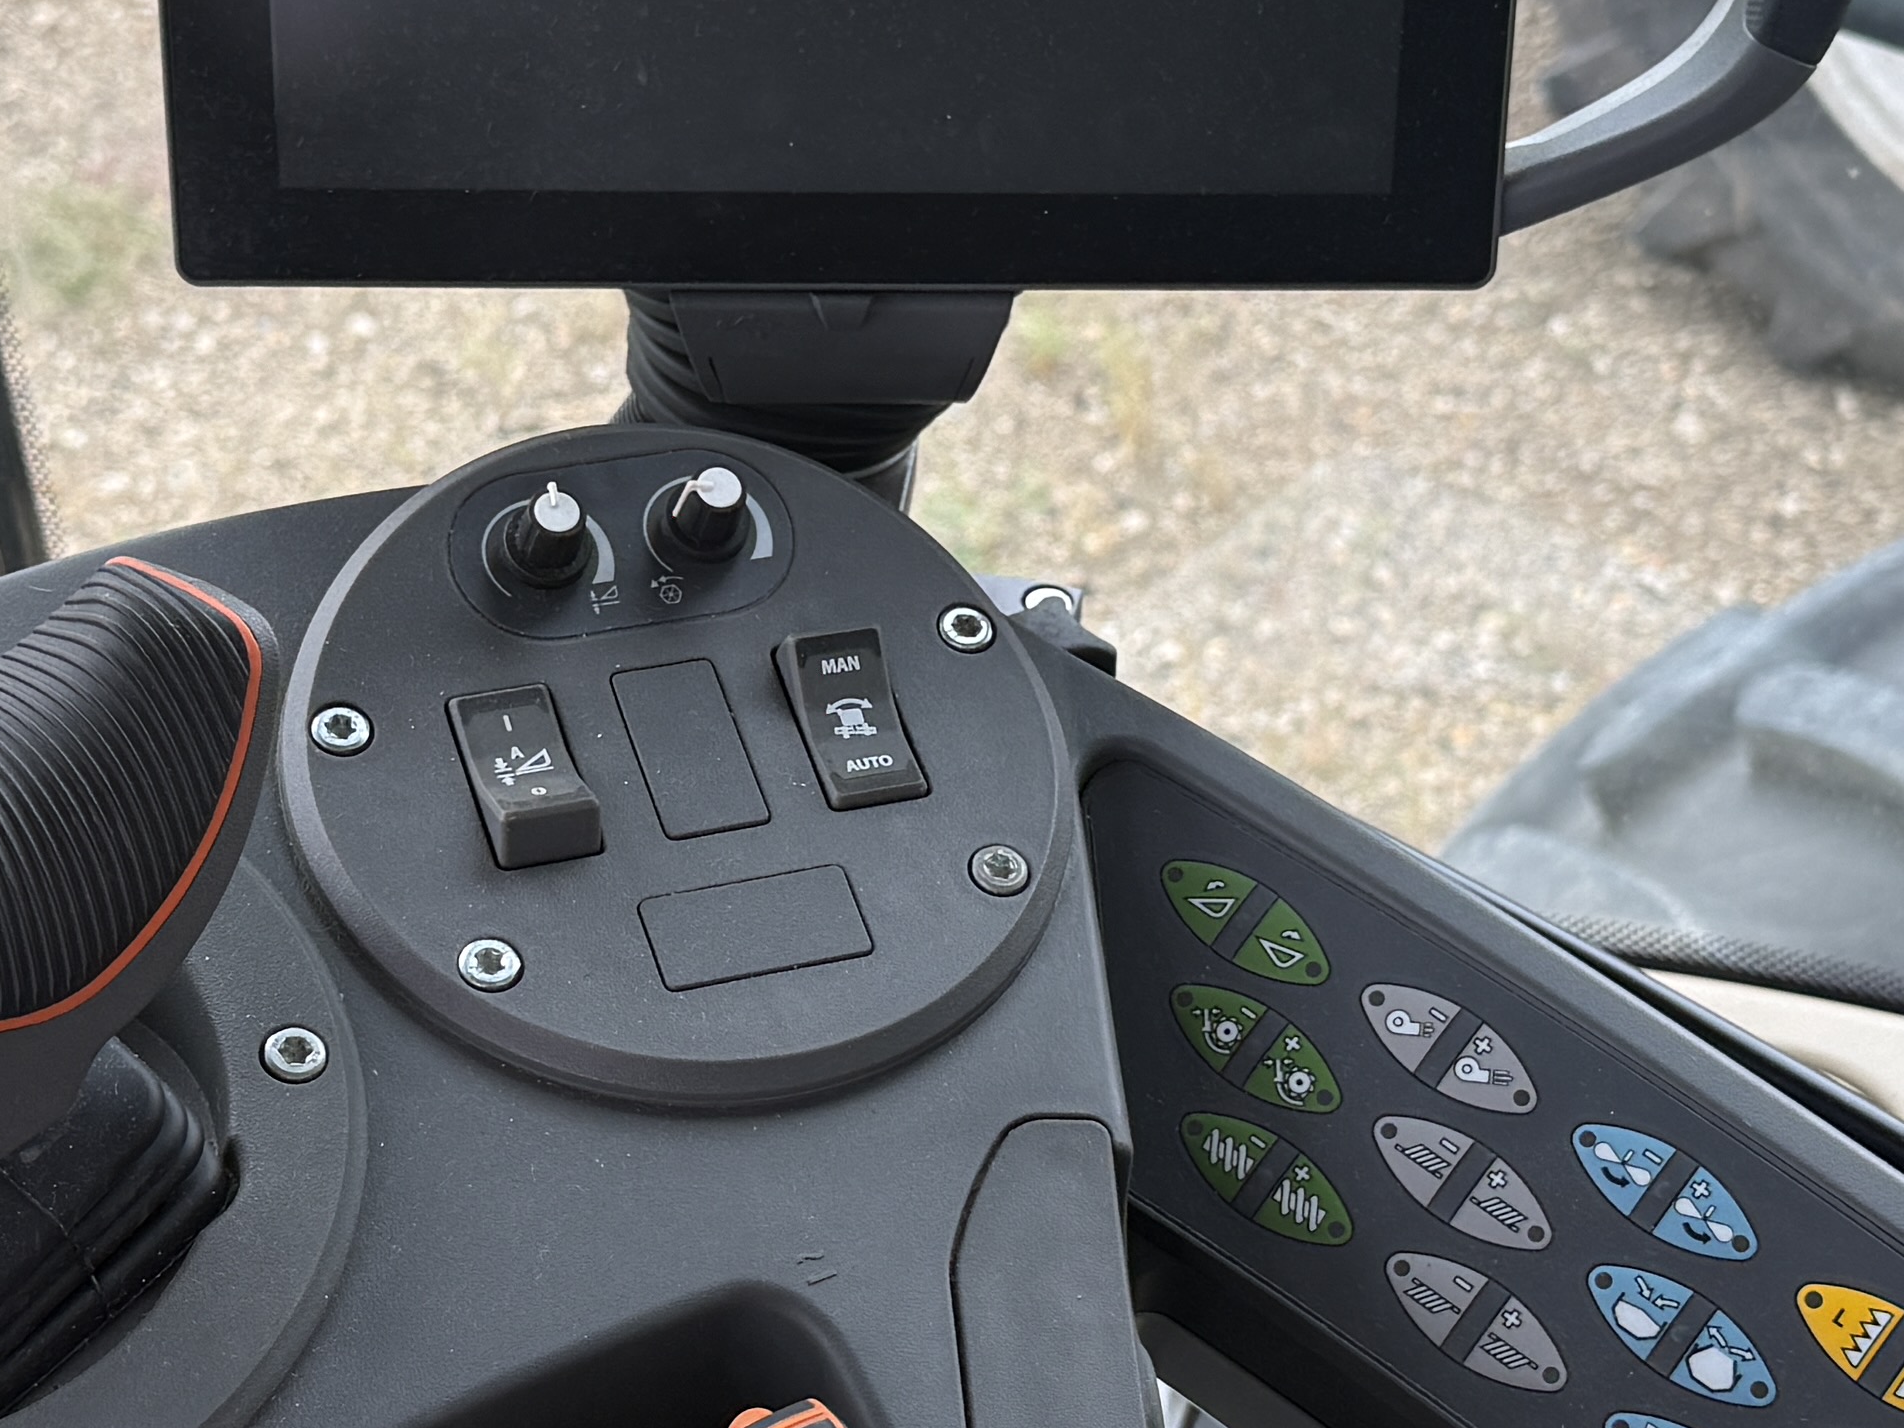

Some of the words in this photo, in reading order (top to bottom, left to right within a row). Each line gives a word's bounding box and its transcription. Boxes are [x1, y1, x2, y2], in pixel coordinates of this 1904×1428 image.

[821, 655, 861, 675] MAN
[846, 754, 894, 773] AUTO
[1831, 1308, 1846, 1328] L
